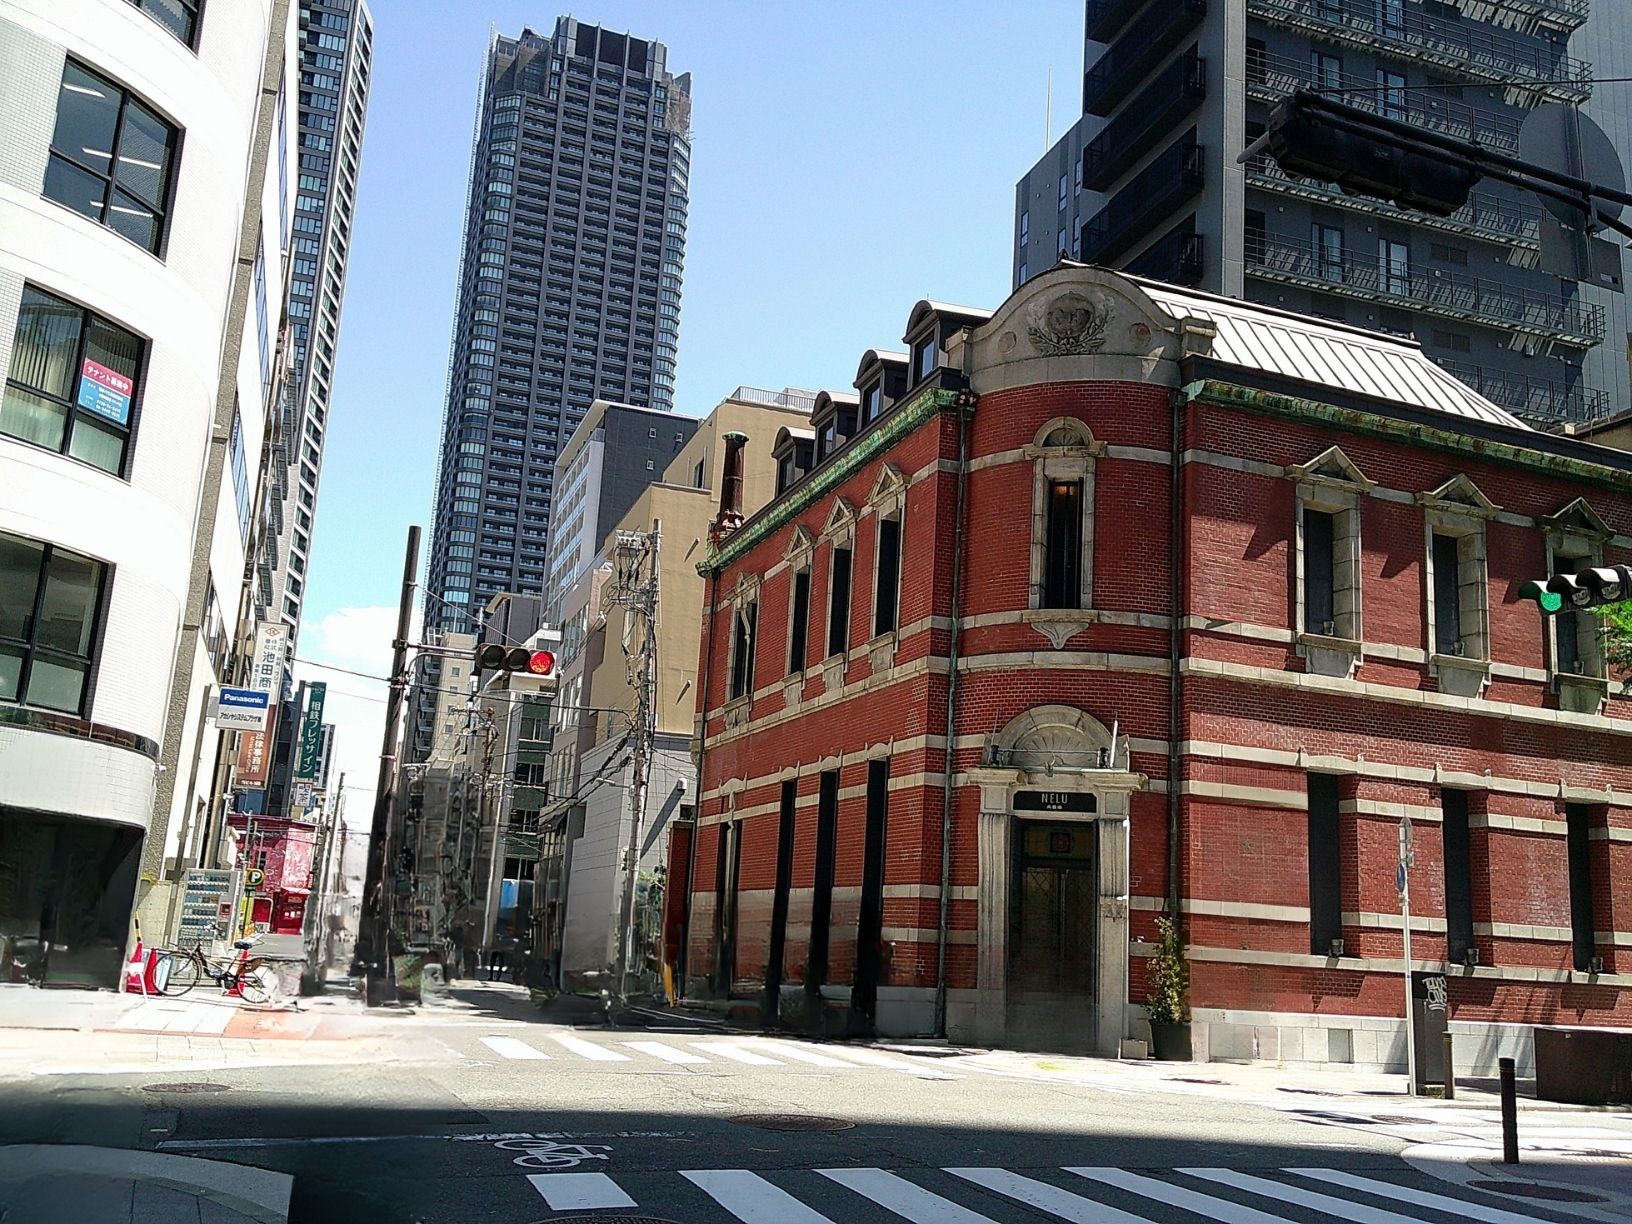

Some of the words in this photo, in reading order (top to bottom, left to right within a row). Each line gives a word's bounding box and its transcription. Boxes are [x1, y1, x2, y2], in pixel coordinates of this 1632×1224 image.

[258, 651, 276, 693] 池田商
[224, 693, 264, 705] Panasonic
[302, 700, 321, 773] 相鉄フレッサイン
[1041, 793, 1068, 804] NELU
[252, 871, 261, 883] P
